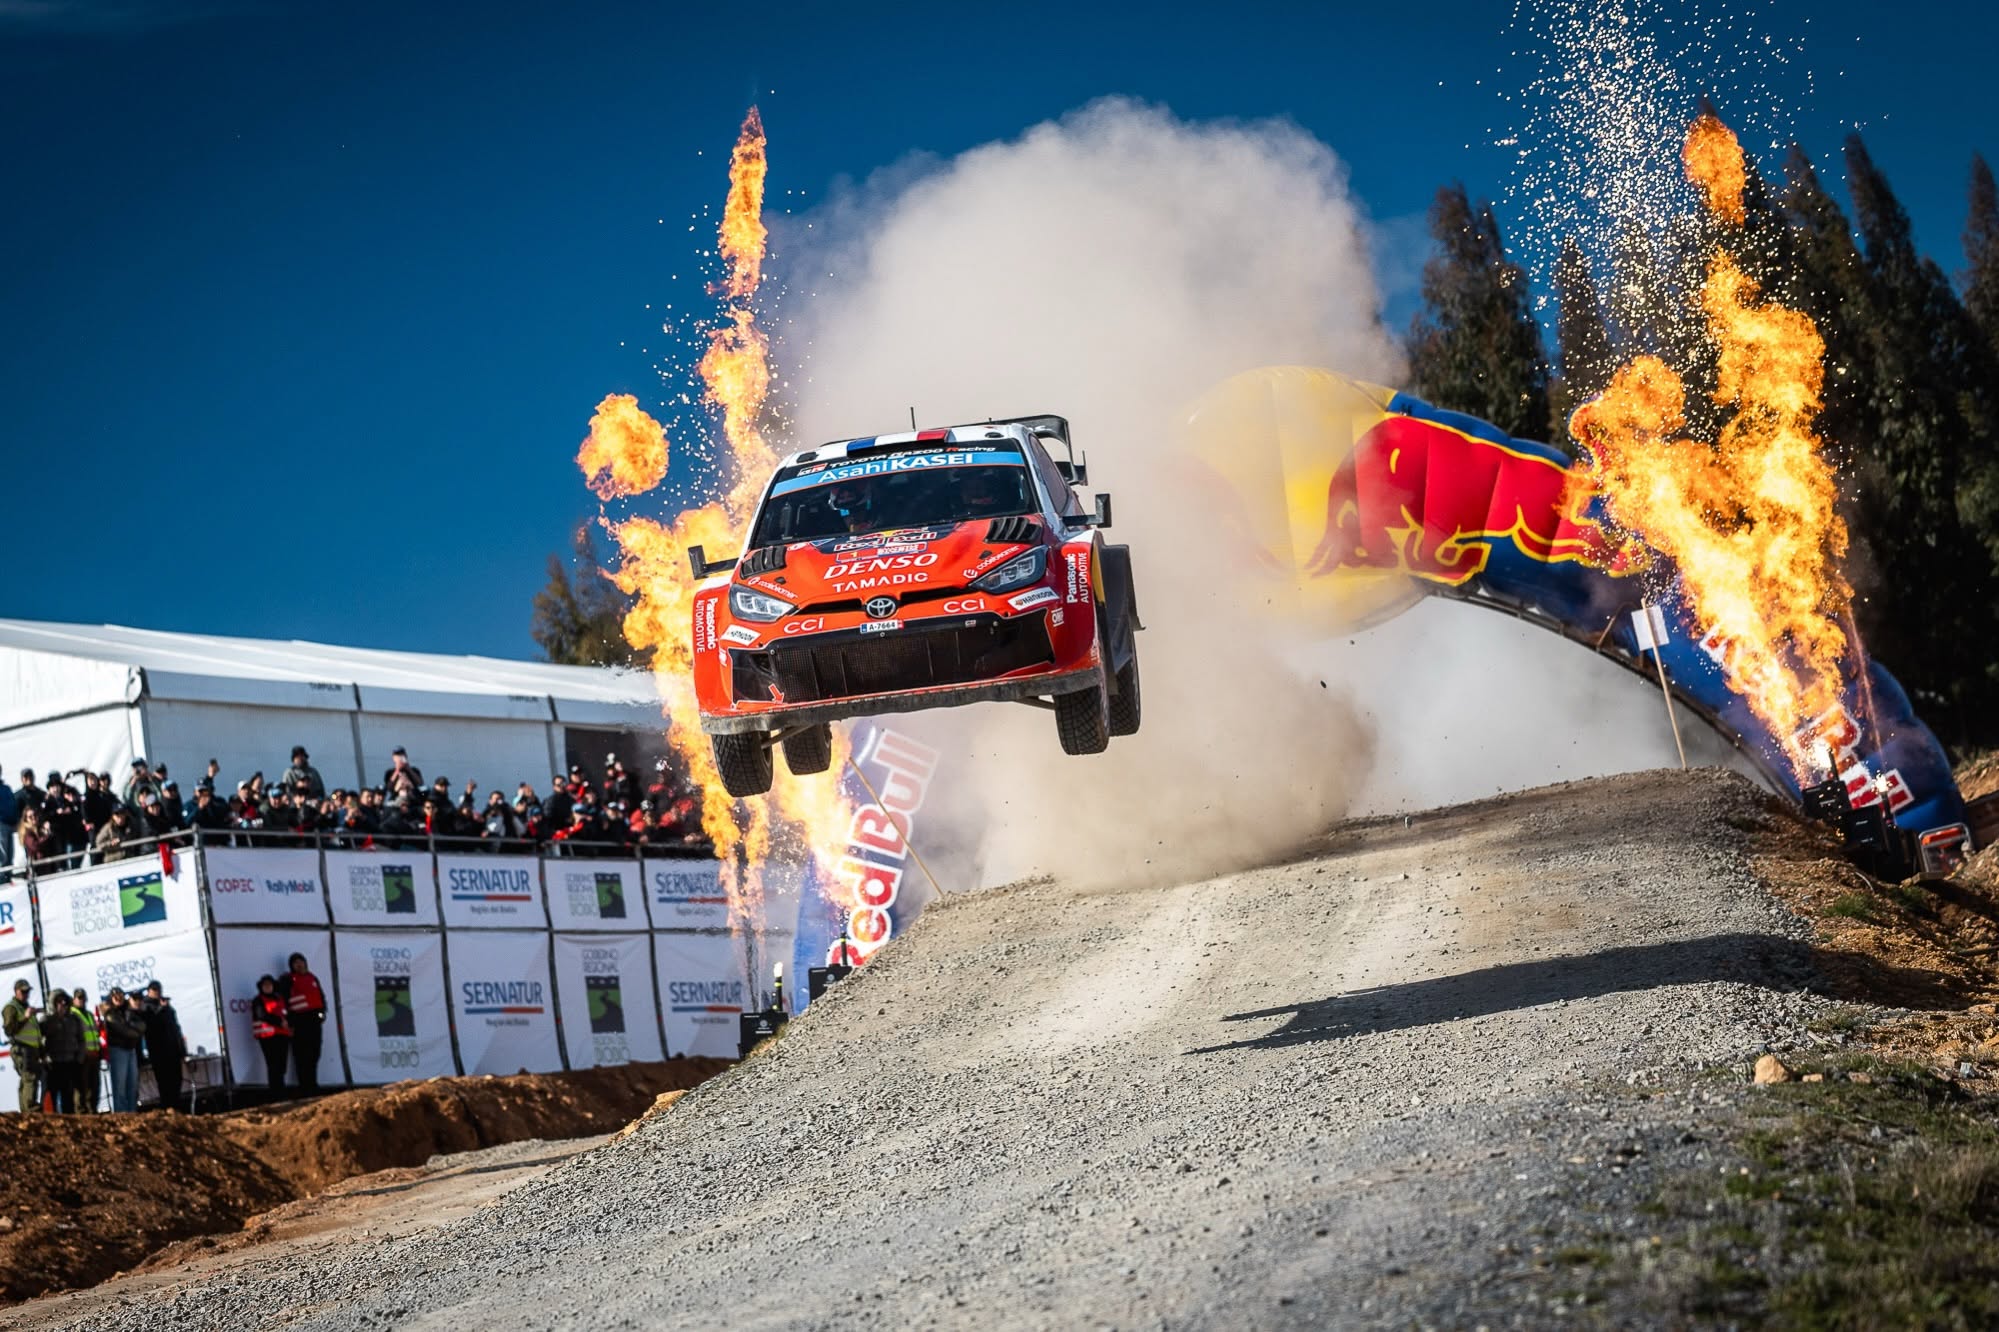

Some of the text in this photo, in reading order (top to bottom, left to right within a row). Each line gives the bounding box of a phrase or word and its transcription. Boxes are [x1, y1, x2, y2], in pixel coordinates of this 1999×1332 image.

[829, 454, 887, 468] TOYOTA
[946, 445, 997, 454] Racing
[834, 536, 886, 552] Red
[886, 531, 938, 547] Bull
[824, 553, 939, 580] DENSO
[1065, 553, 1078, 604] Panasonic
[1077, 552, 1089, 604] AUTOMOTIVE
[832, 572, 929, 593] TAMADIC
[943, 598, 986, 613] CCI
[695, 599, 705, 654] AUTOMOTIVE
[706, 597, 719, 650] Panasonic
[783, 617, 825, 635] CCI
[868, 622, 896, 632] A-7664
[848, 728, 940, 861] Bull
[215, 878, 315, 896] COPEC RallyMobil
[449, 868, 531, 892] SERNATUR
[655, 872, 726, 894] SERNATU
[463, 981, 544, 1005] SERNATUR
[669, 980, 743, 1004] SERNATUR
